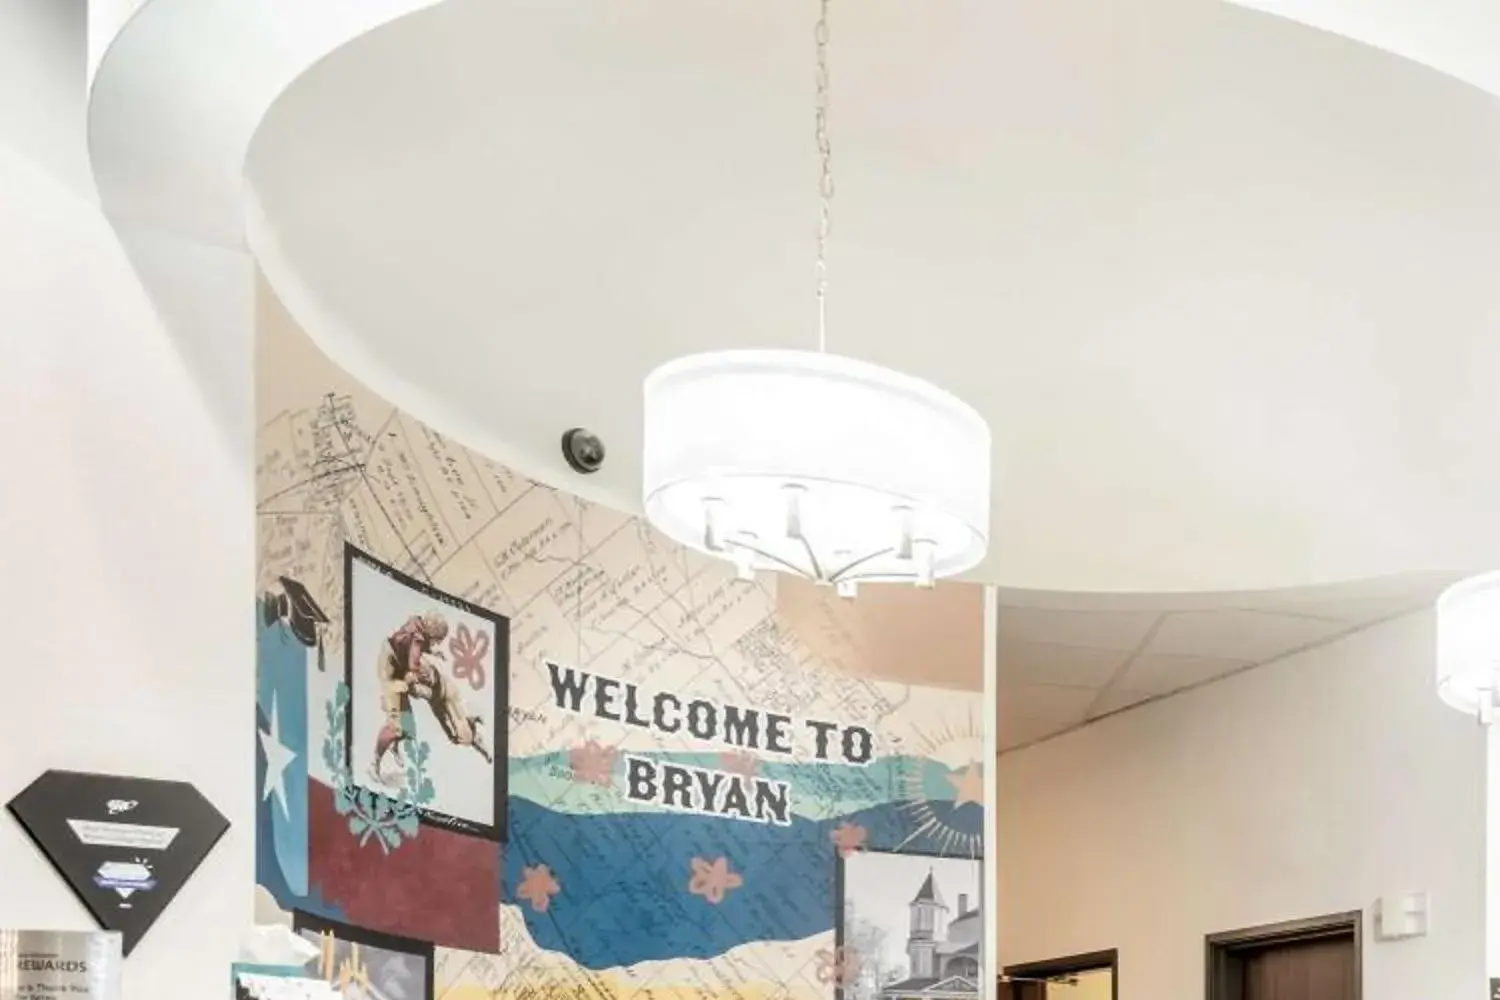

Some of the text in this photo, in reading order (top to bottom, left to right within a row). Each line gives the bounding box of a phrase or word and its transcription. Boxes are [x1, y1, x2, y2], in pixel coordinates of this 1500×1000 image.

[546, 663, 874, 765] WELCOME TO
[627, 757, 789, 823] BRYAN
